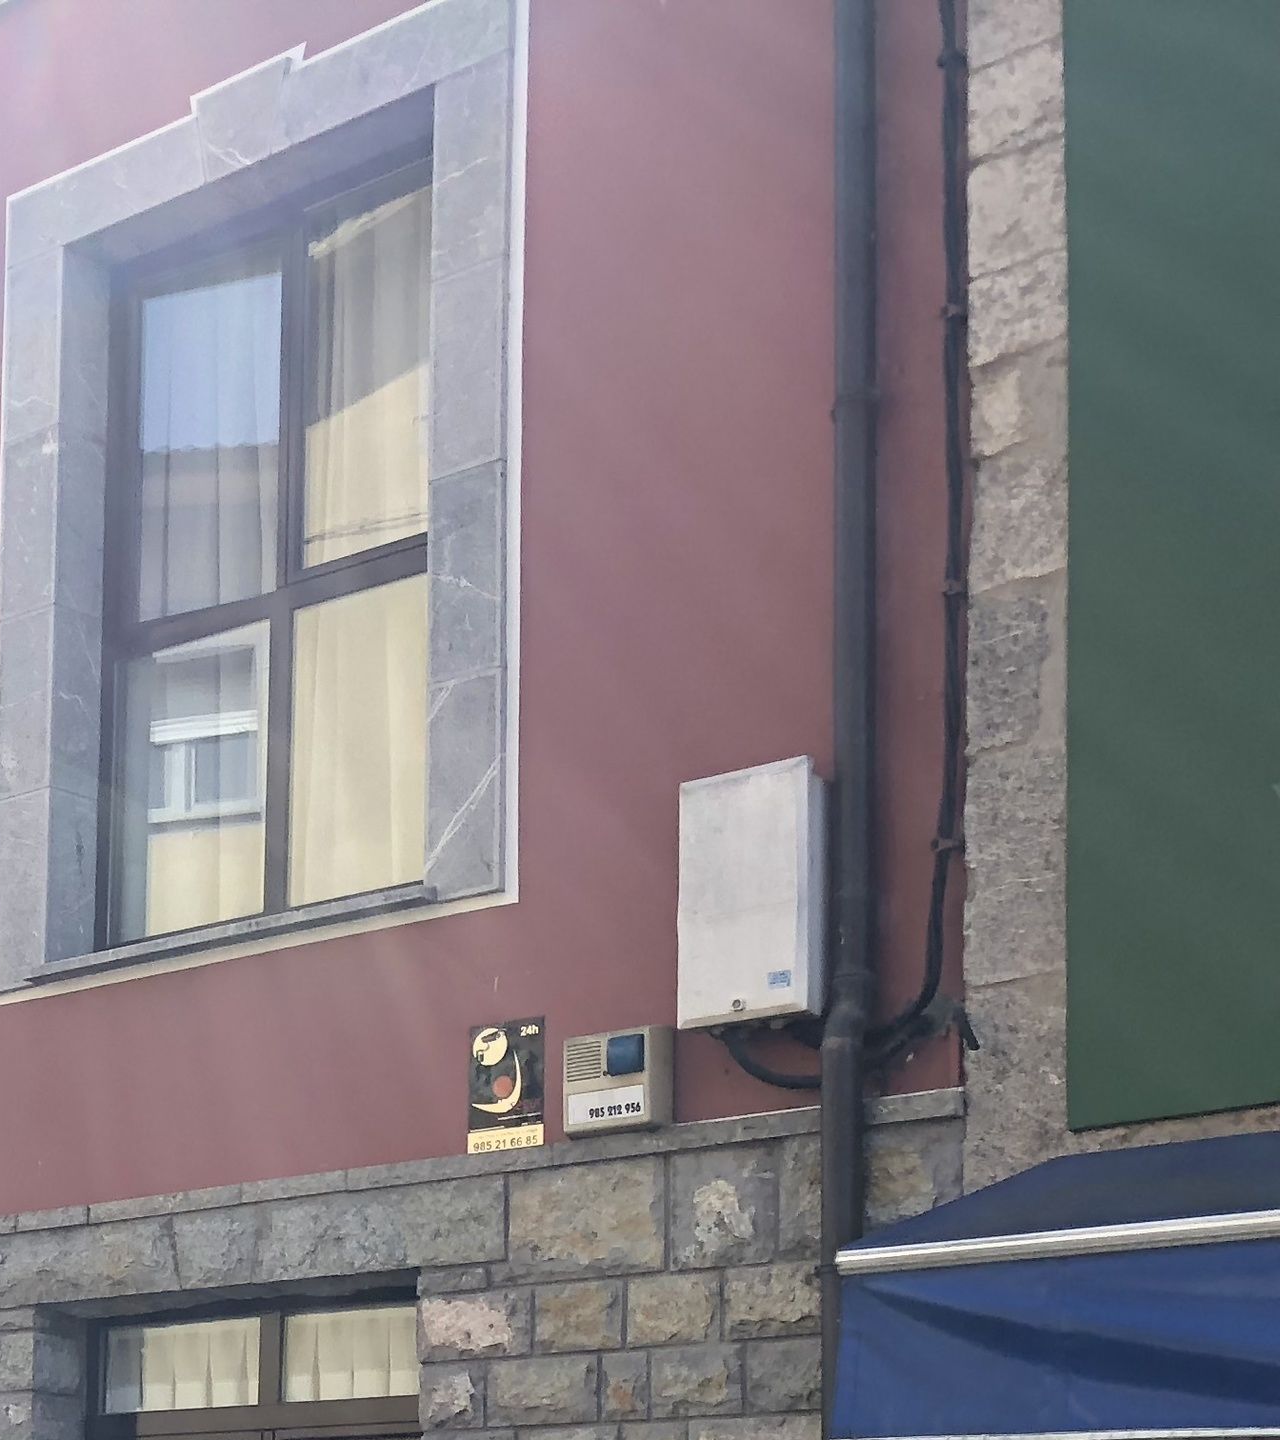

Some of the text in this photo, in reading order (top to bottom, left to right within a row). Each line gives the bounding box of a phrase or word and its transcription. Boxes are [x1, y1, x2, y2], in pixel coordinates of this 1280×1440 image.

[520, 1024, 539, 1037] 24h
[589, 1102, 641, 1119] 985 212 956
[473, 1140, 492, 1152] 985
[495, 1138, 507, 1150] 21
[510, 1136, 523, 1147] 66
[525, 1134, 538, 1145] 85
